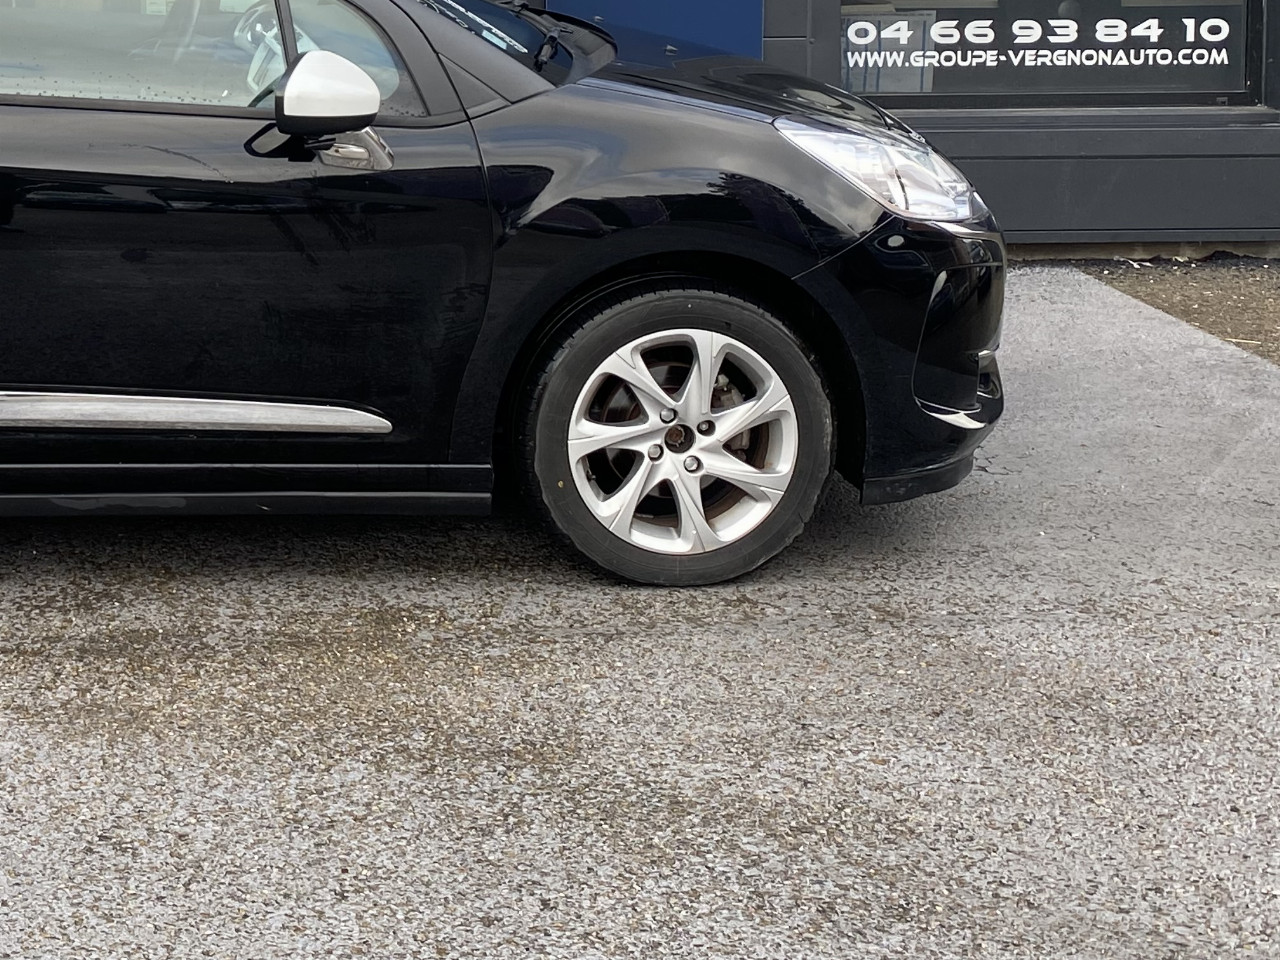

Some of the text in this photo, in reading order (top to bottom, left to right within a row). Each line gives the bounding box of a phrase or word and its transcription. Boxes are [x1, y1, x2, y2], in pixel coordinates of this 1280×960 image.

[848, 19, 1229, 44] 04 66 93 84 10
[847, 49, 1228, 67] WWW.GROUPE-VERGNONAUTO.COM
